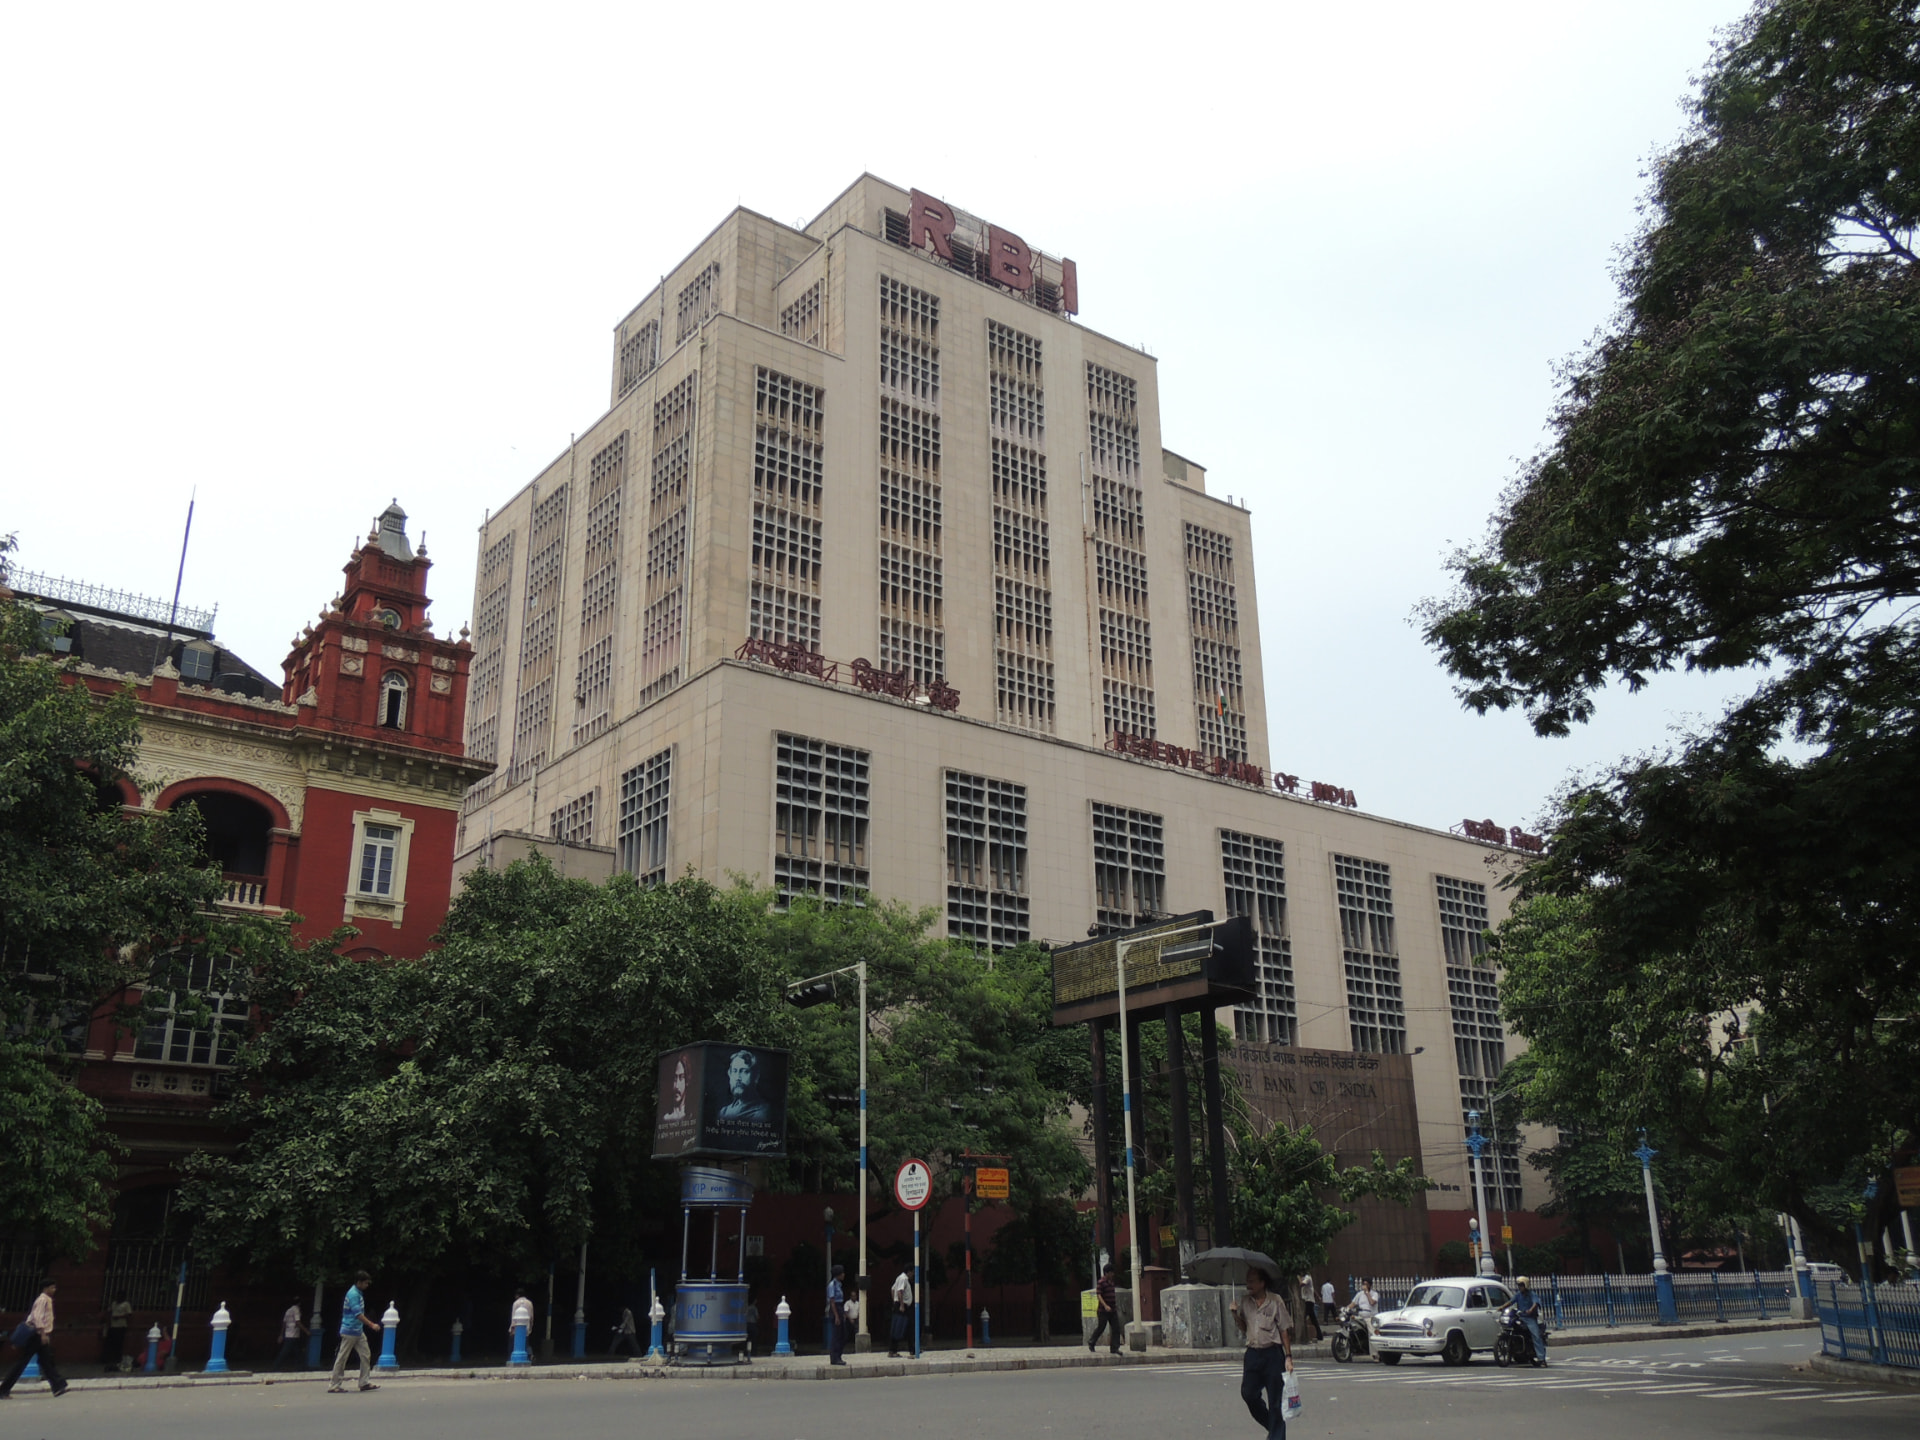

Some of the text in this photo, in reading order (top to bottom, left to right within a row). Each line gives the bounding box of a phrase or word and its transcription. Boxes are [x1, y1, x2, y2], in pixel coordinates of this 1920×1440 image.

[910, 187, 1078, 316] RBI
[1112, 730, 1358, 808] RESERVE BANK OF INDIA
[1263, 1076, 1297, 1094] BANK
[1310, 1080, 1328, 1096] OF
[1337, 1081, 1378, 1098] INDIA
[687, 1303, 708, 1320] KIP
